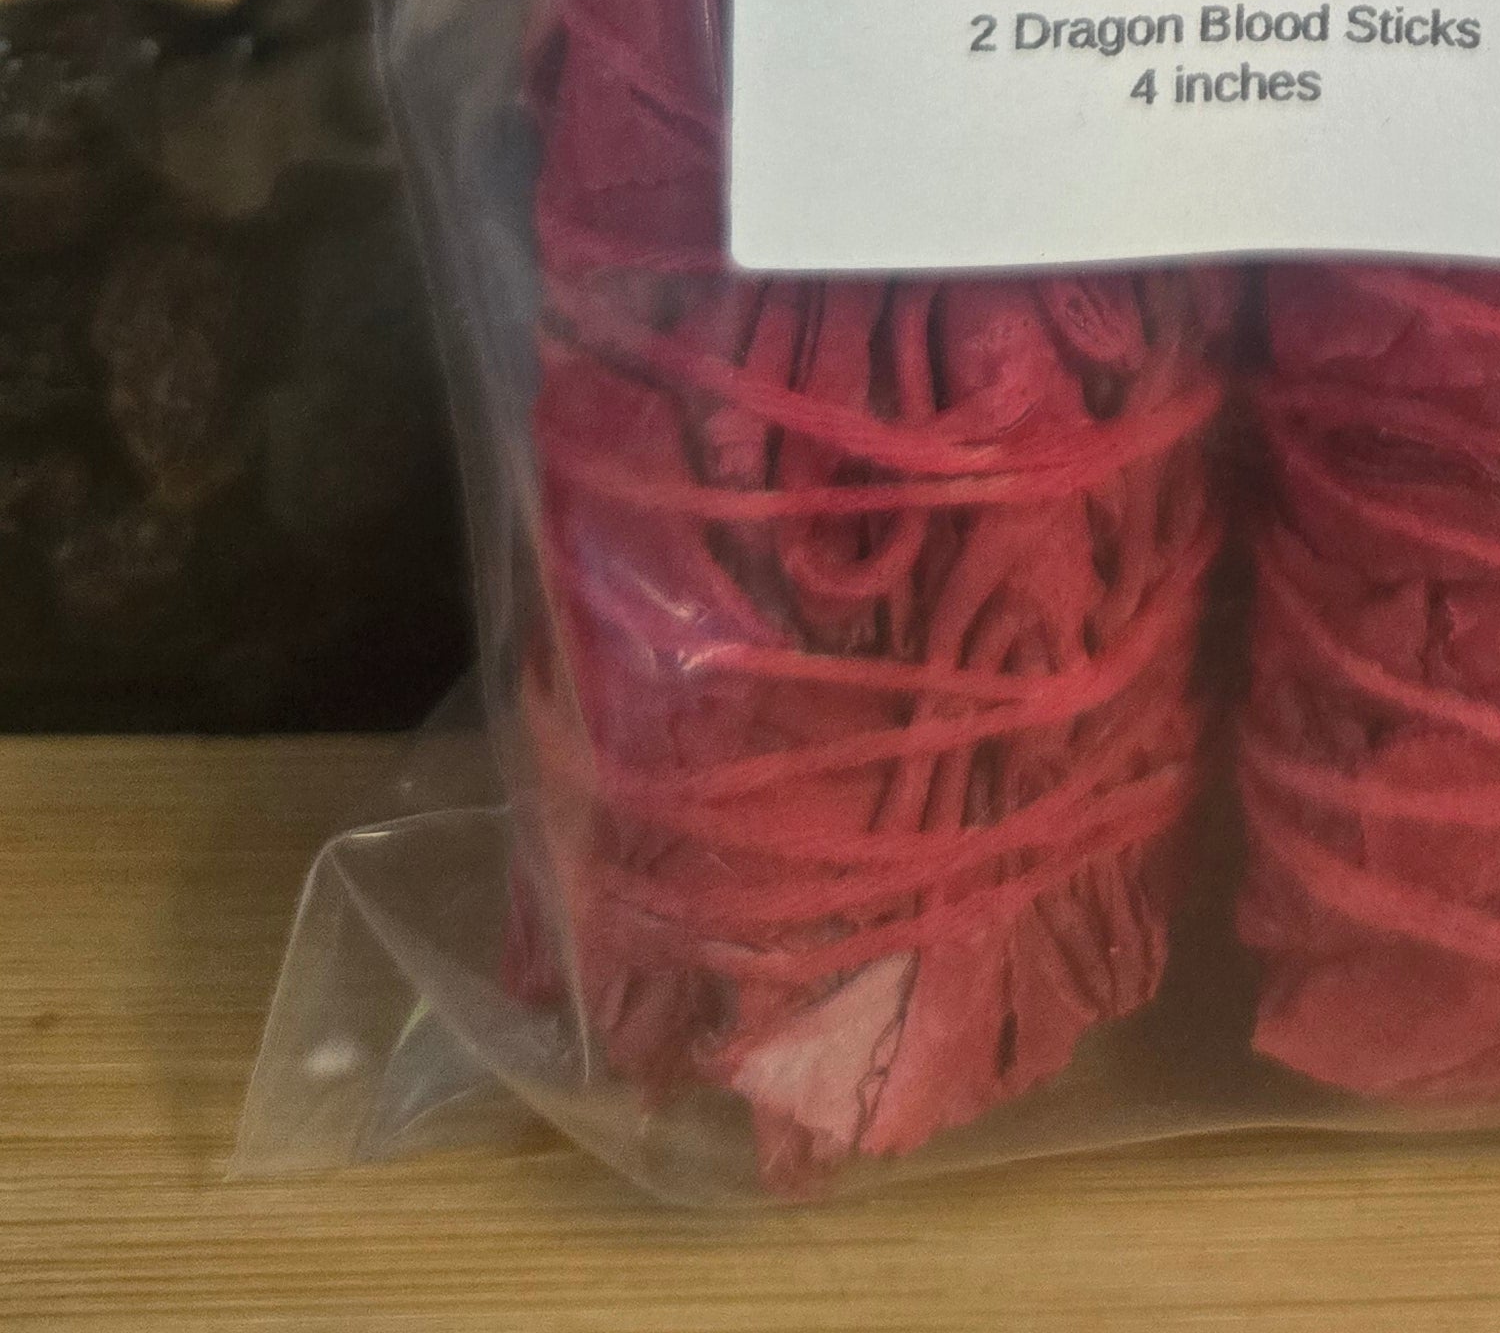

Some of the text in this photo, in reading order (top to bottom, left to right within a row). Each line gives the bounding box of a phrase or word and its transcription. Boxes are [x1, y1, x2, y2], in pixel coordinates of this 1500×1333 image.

[968, 3, 1482, 58] 2 Dragon Blood Sticks
[1129, 61, 1323, 107] 4 inches
